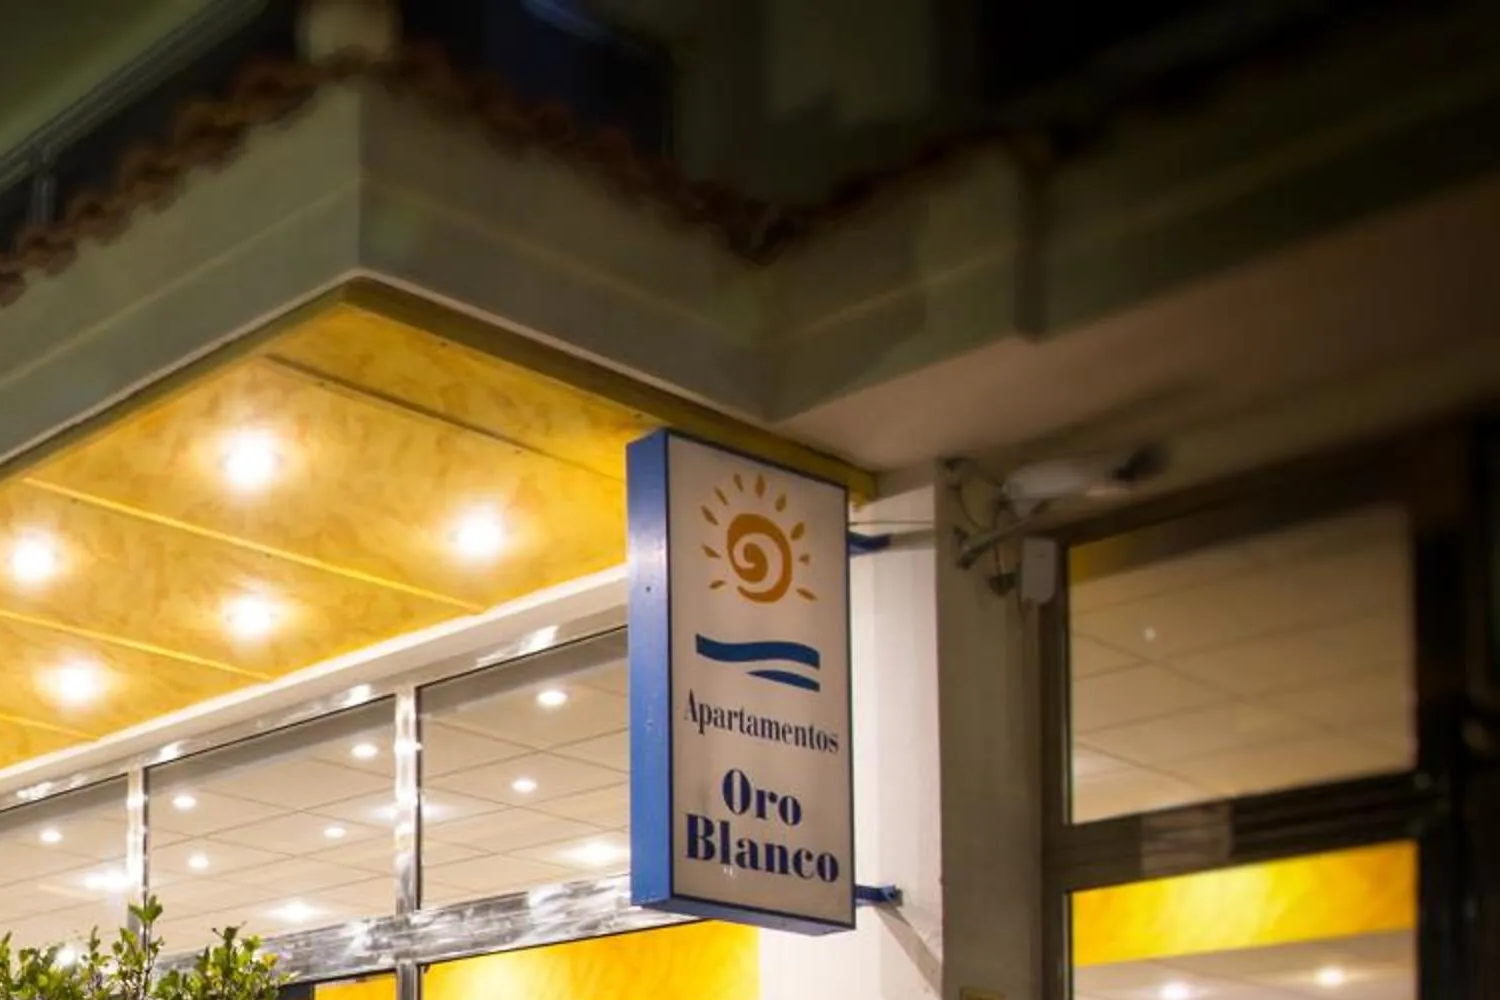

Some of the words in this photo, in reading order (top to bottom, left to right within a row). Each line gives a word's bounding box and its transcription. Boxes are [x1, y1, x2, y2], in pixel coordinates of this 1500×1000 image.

[683, 688, 839, 753] Apartamentos
[722, 768, 802, 827] Oro
[686, 813, 839, 884] Blanco
